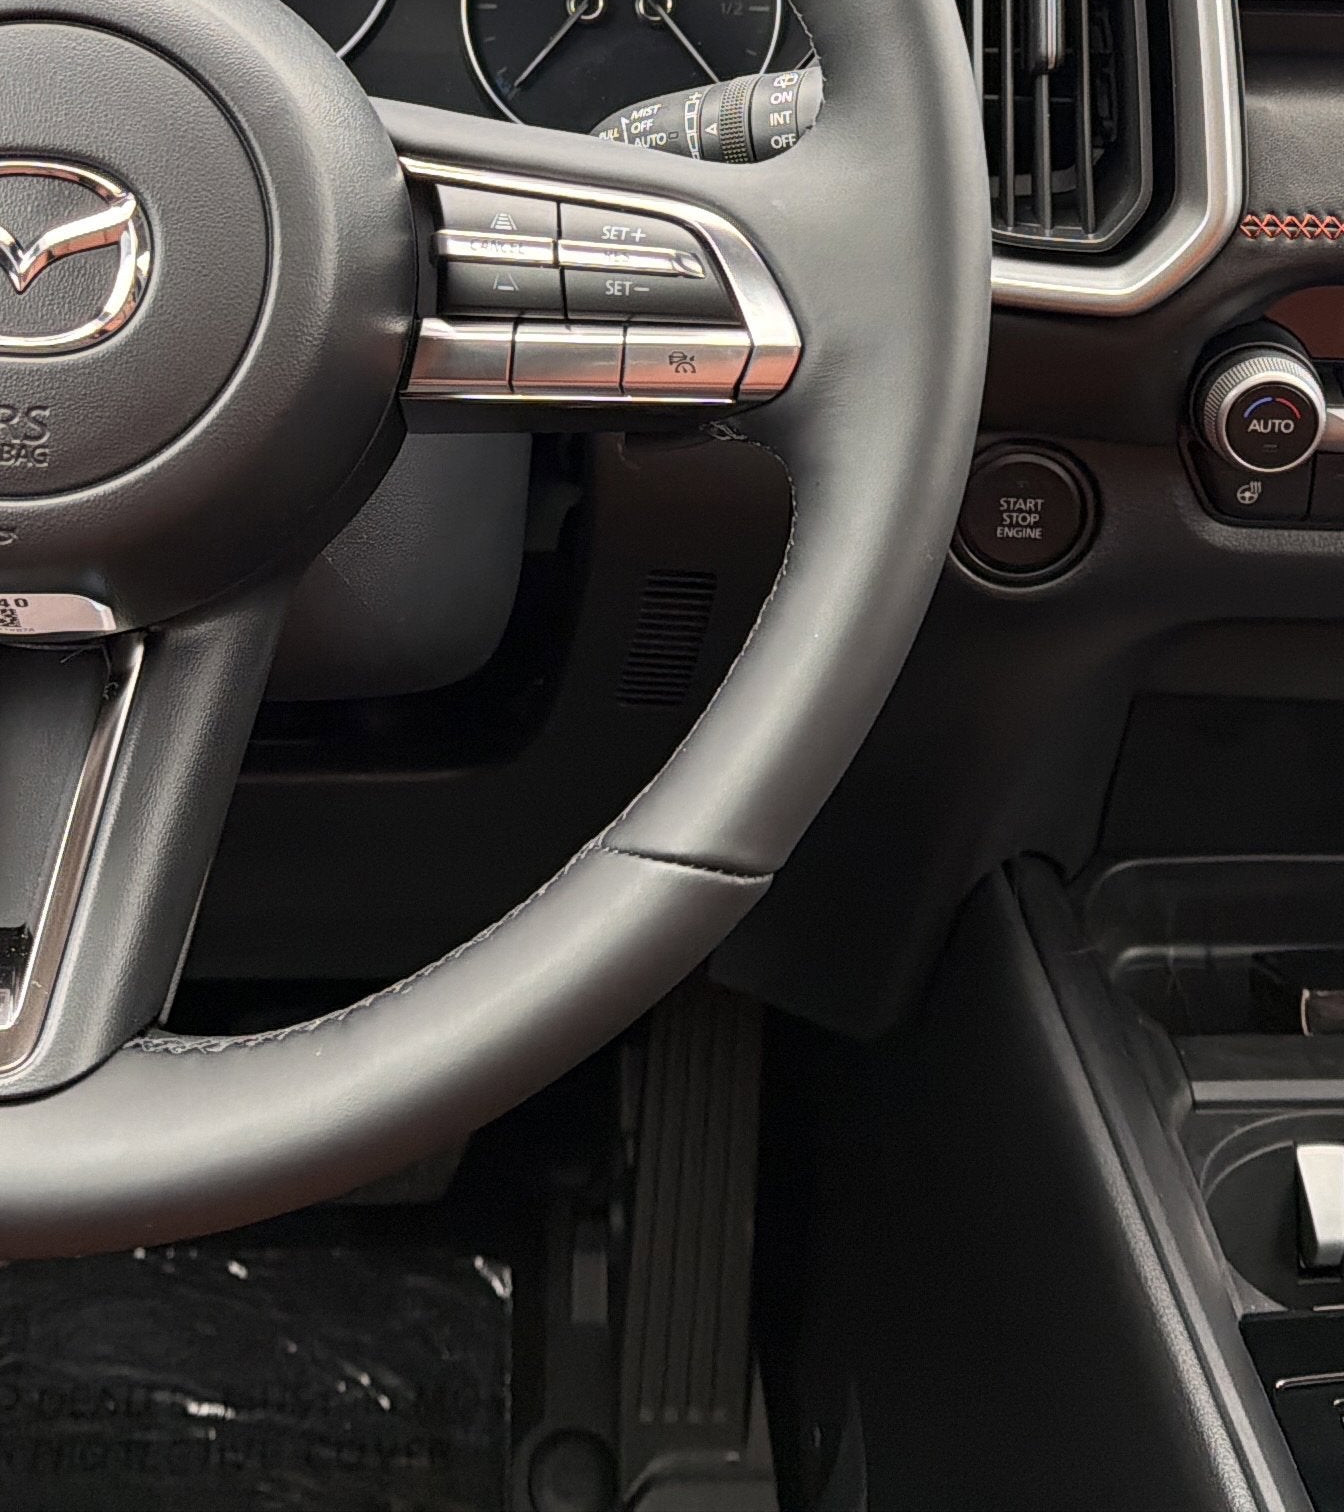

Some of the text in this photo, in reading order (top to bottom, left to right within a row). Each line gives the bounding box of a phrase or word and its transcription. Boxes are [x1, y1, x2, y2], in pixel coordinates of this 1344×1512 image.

[720, 2, 744, 16] 1/2
[770, 91, 793, 104] ON
[631, 104, 662, 119] MIST
[769, 111, 792, 126] INT
[631, 119, 653, 134] OFF
[634, 133, 667, 148] AUTO
[771, 134, 796, 148] OFF
[1248, 419, 1294, 434] AUTO
[999, 498, 1043, 512] START
[1002, 512, 1039, 526] STOP
[996, 526, 1043, 540] ENGINE
